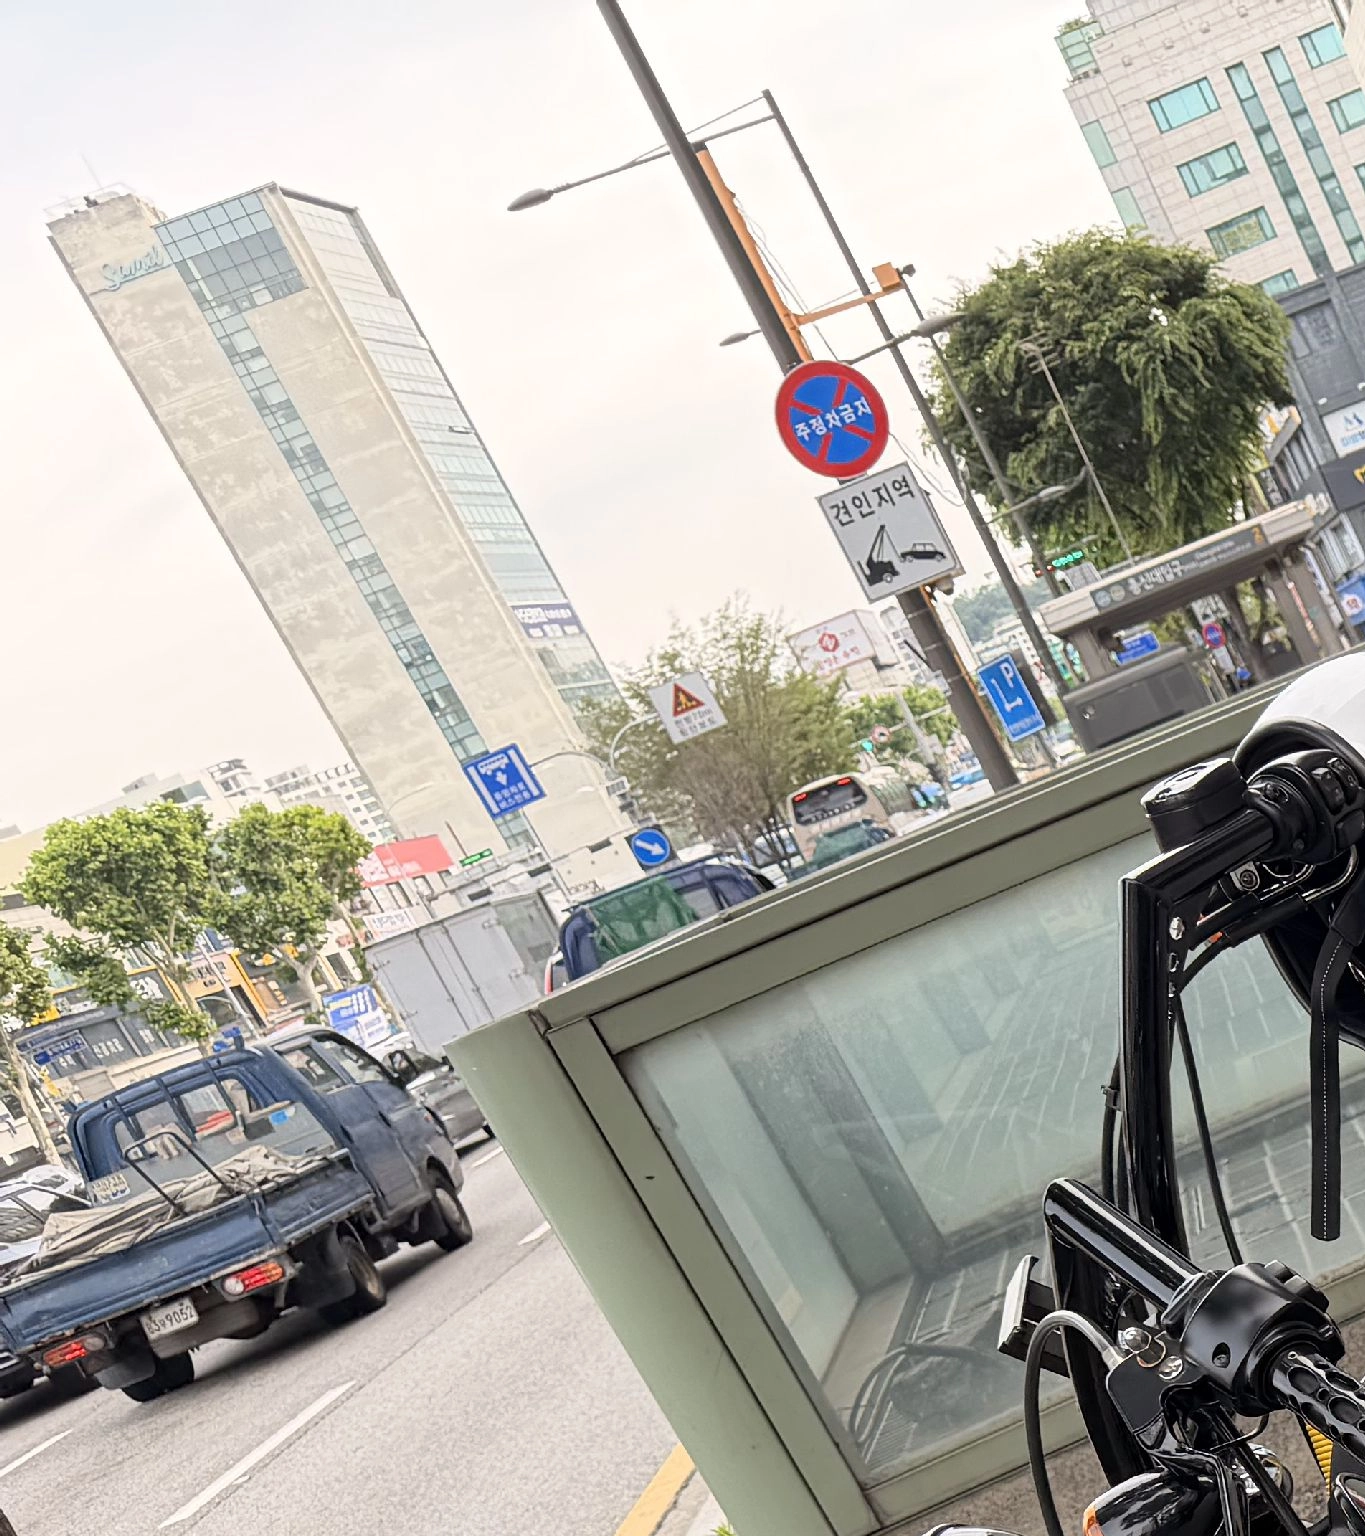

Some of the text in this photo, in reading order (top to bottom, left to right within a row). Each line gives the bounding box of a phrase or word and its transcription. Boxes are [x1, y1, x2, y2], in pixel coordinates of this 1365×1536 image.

[794, 396, 872, 442] 주정차금지
[829, 474, 916, 527] 견인지역
[1000, 661, 1016, 685] P
